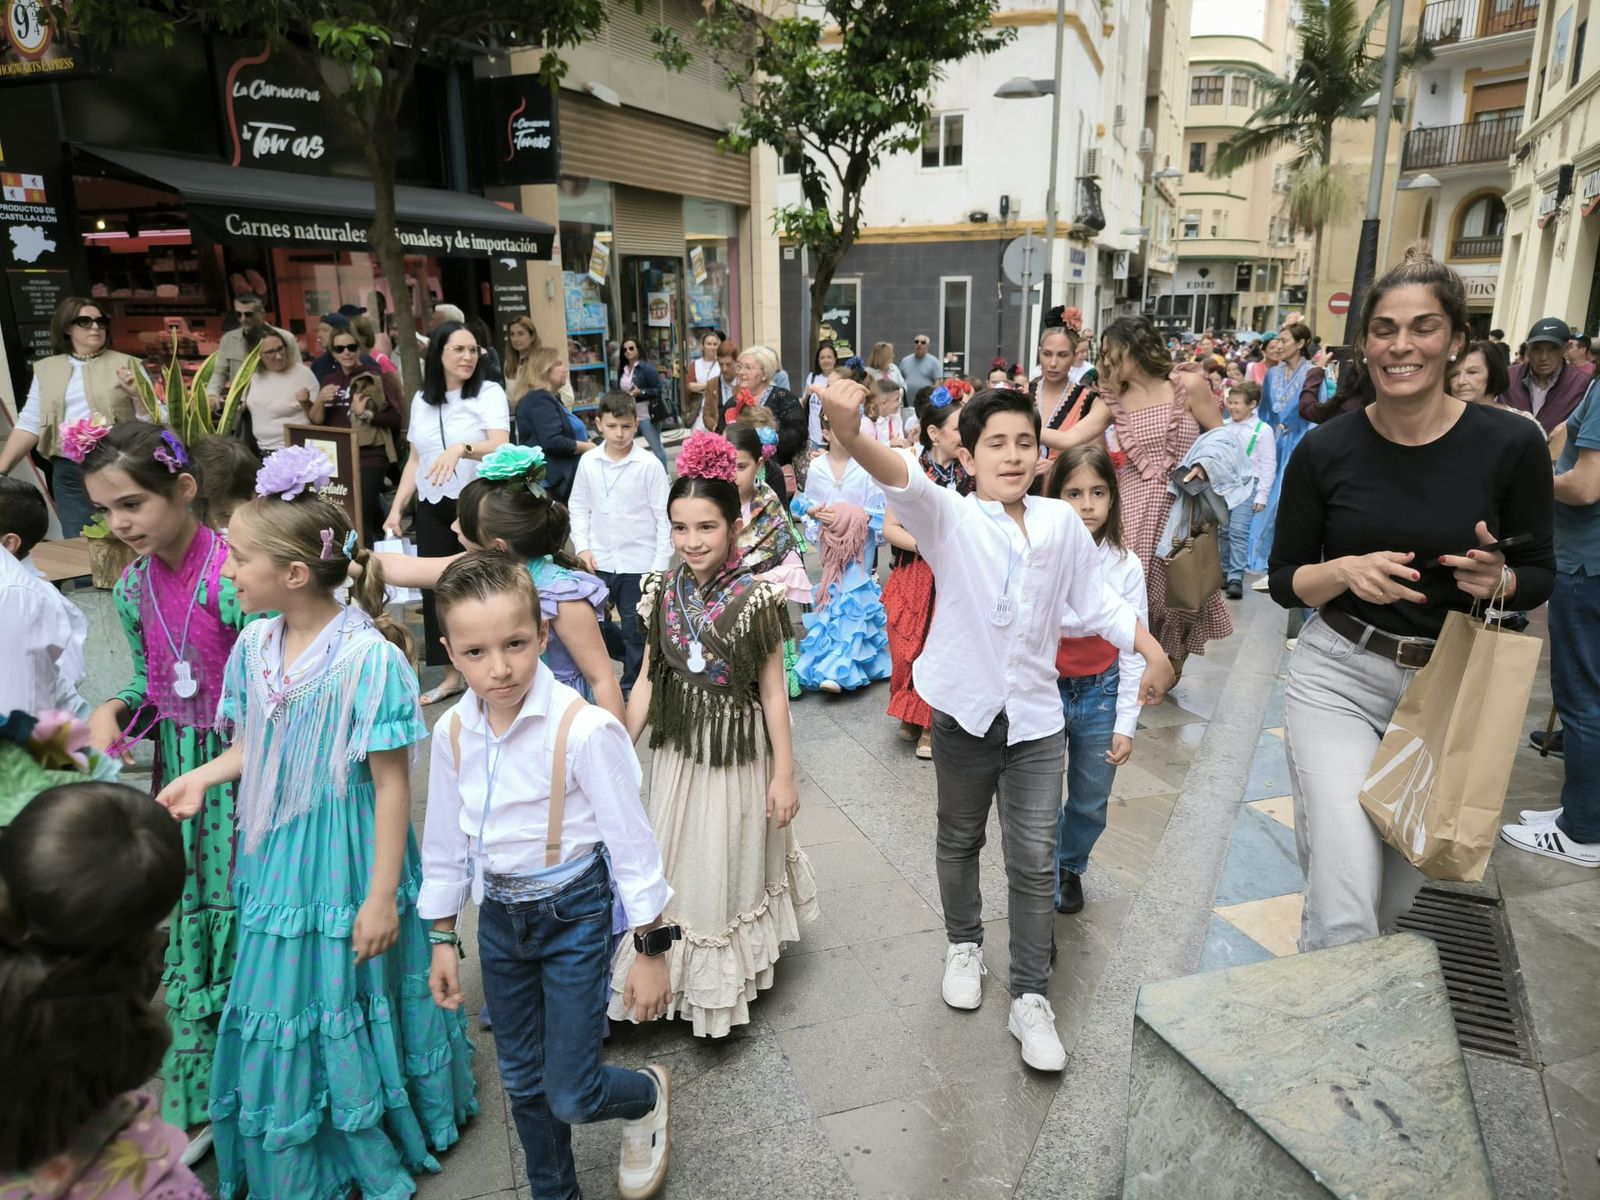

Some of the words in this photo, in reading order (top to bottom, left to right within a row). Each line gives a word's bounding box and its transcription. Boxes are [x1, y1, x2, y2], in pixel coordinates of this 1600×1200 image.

[0, 203, 44, 214] PRODUCTOS
[45, 206, 56, 214] DE
[225, 213, 291, 238] Carnes
[294, 221, 368, 243] naturales
[444, 234, 453, 253] y
[454, 230, 471, 249] de
[471, 233, 538, 255] importación
[1115, 253, 1126, 271] R
[1465, 280, 1496, 295] ino
